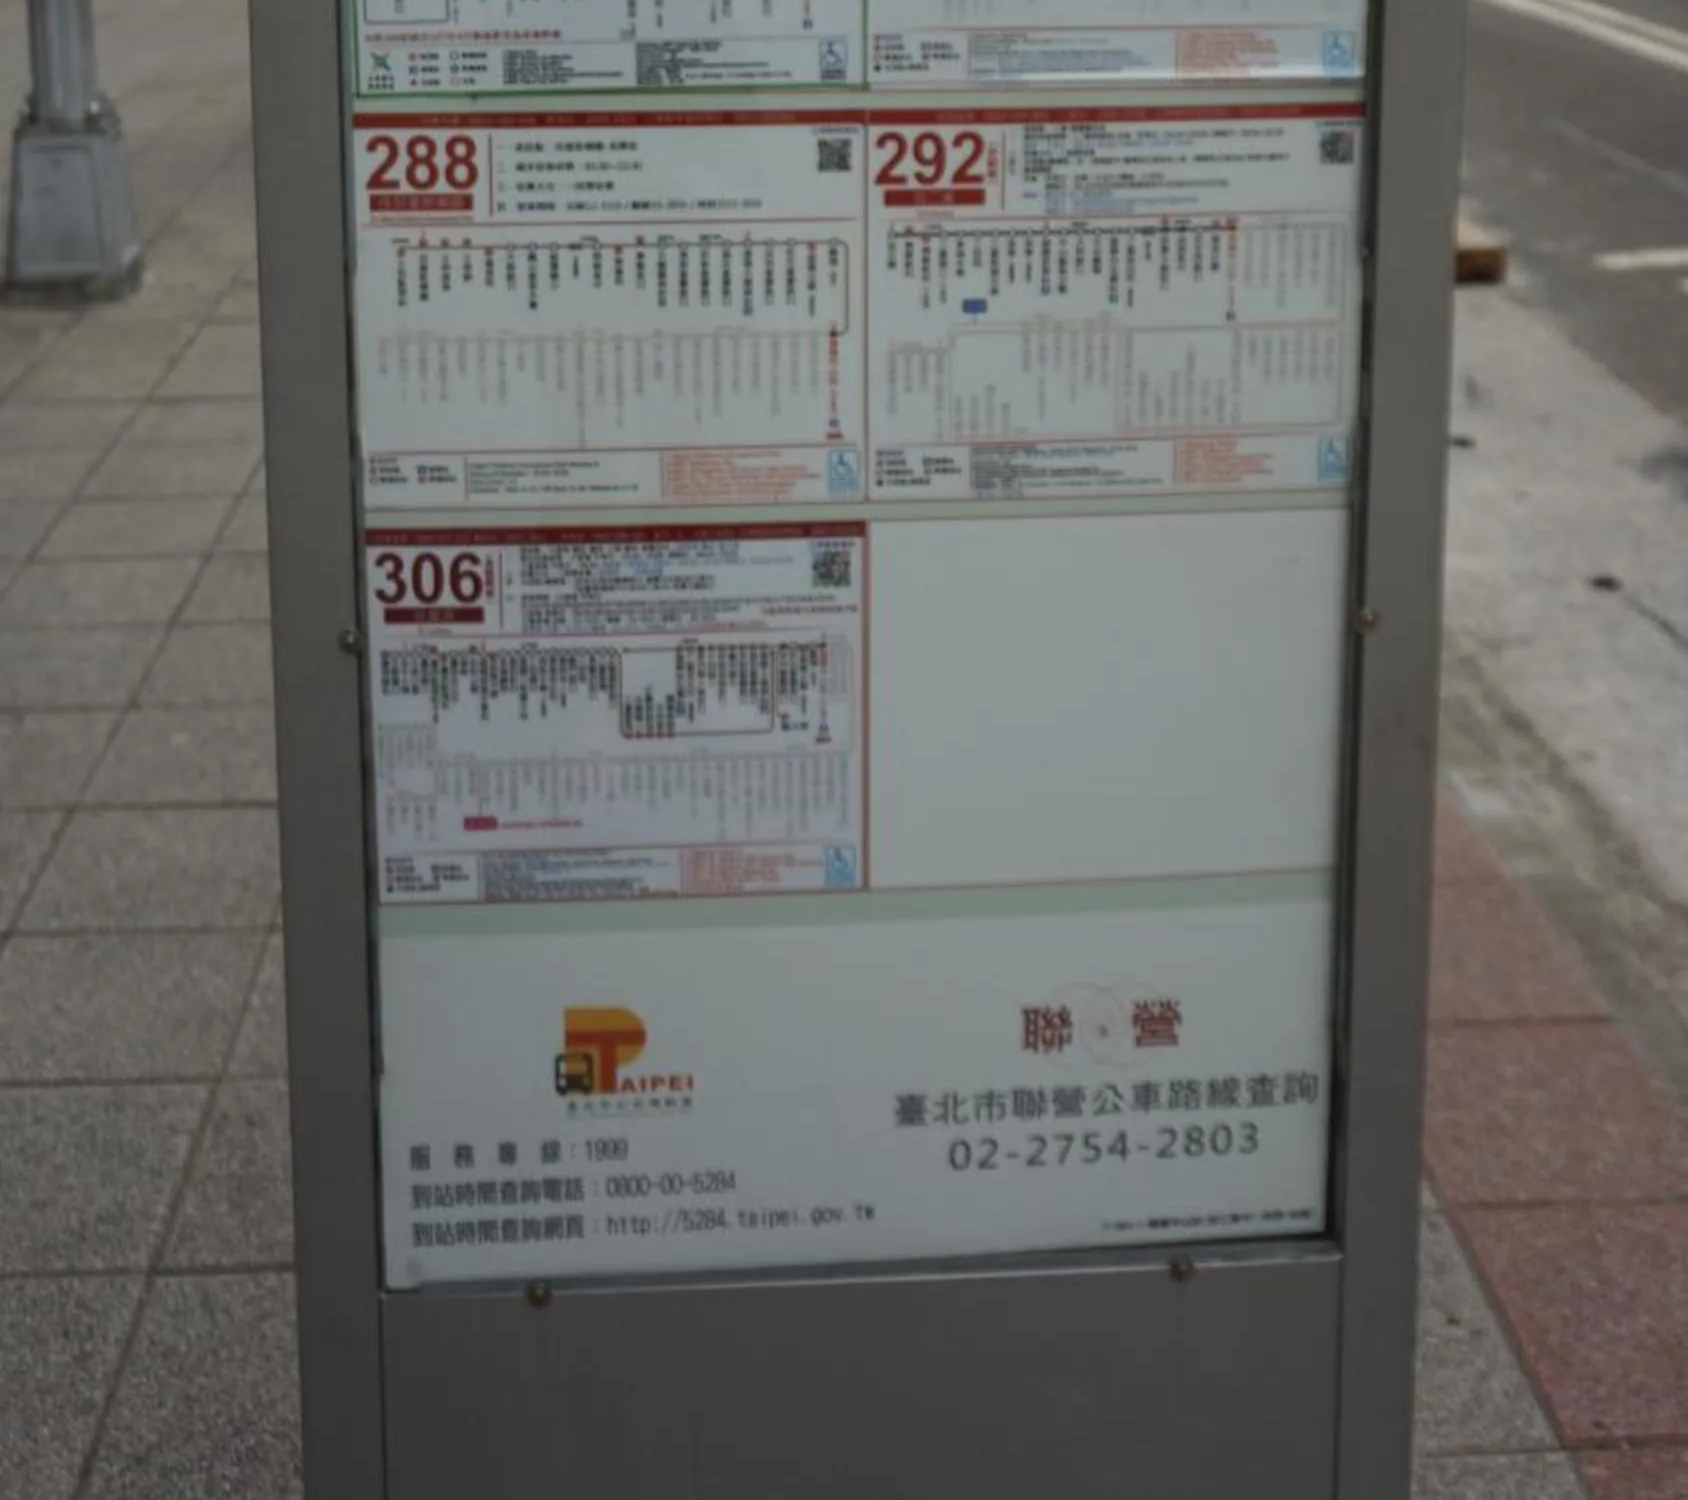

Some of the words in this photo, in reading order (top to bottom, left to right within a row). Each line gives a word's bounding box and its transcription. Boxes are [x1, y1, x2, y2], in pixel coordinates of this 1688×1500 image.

[366, 134, 479, 191] 288
[874, 130, 986, 186] 292
[374, 552, 484, 605] 306
[894, 1070, 1320, 1129] 臺北市聯營公車路線查詢
[949, 1122, 1260, 1171] 02-2754-2803
